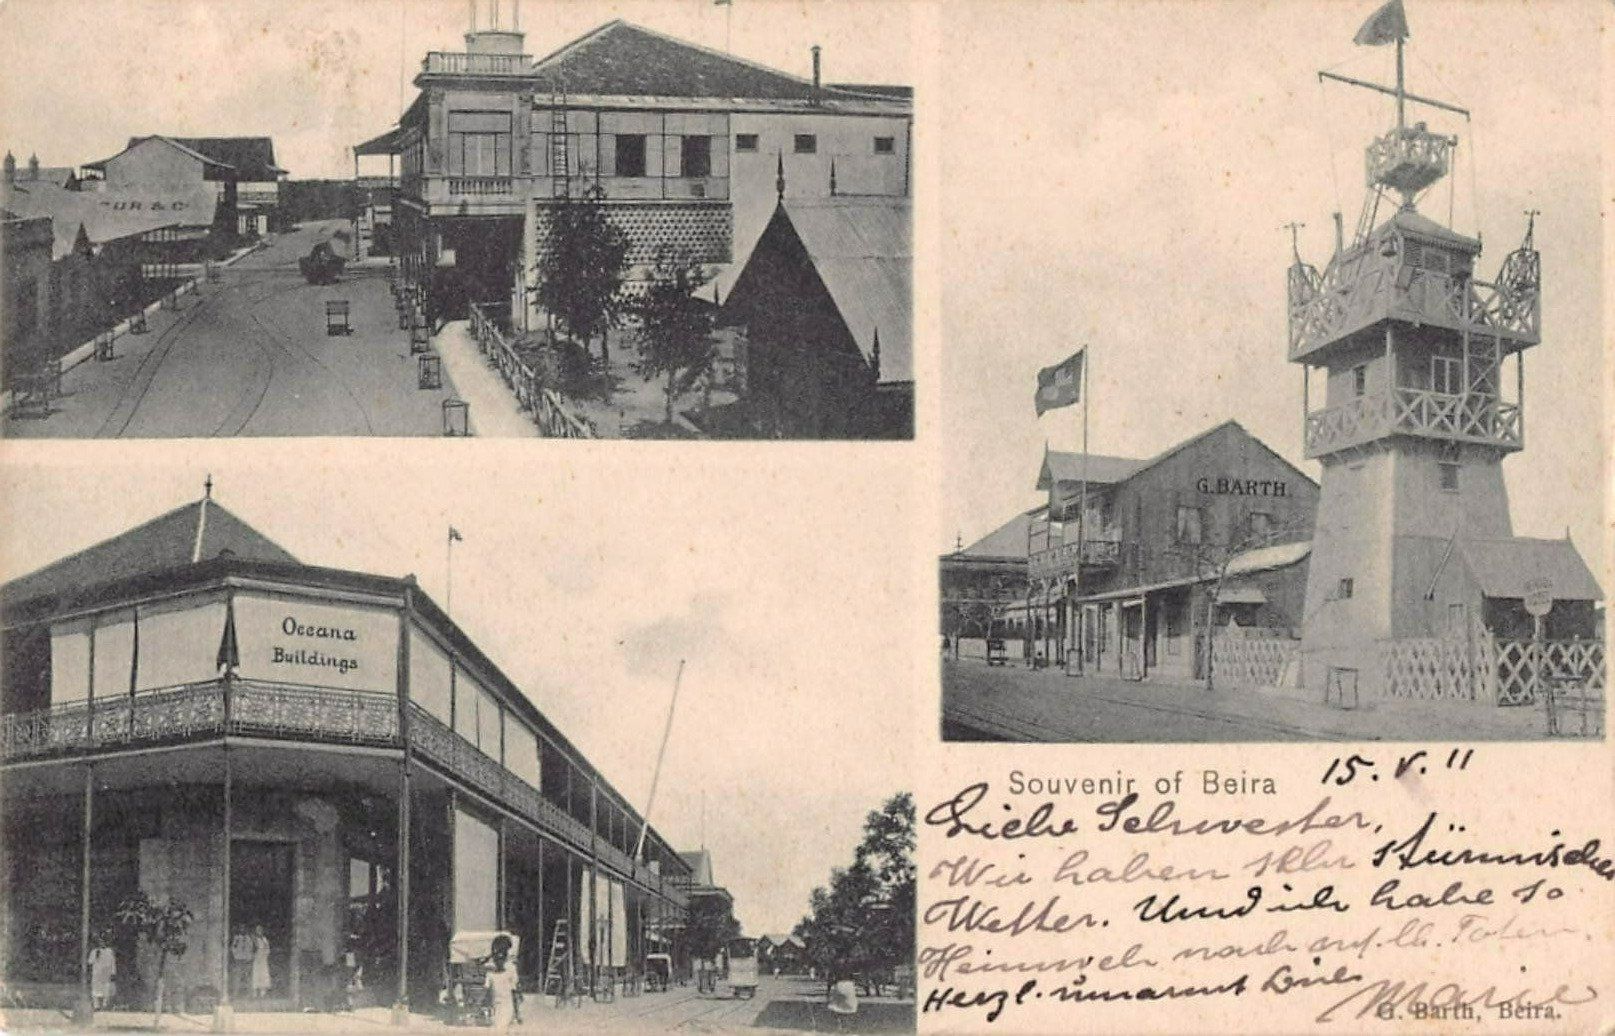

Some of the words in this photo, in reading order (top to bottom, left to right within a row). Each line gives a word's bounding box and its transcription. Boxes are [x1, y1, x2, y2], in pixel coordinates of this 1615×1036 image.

[282, 616, 357, 641] Oceana
[272, 646, 358, 674] Buildings
[1009, 770, 1136, 795] Souvenir
[1155, 770, 1183, 795] of
[1203, 770, 1277, 795] Beira
[1370, 879, 1495, 911] habe
[1377, 1002, 1404, 1021] G.
[1413, 1001, 1482, 1023] Barth,
[1499, 1001, 1562, 1020] Beira.
